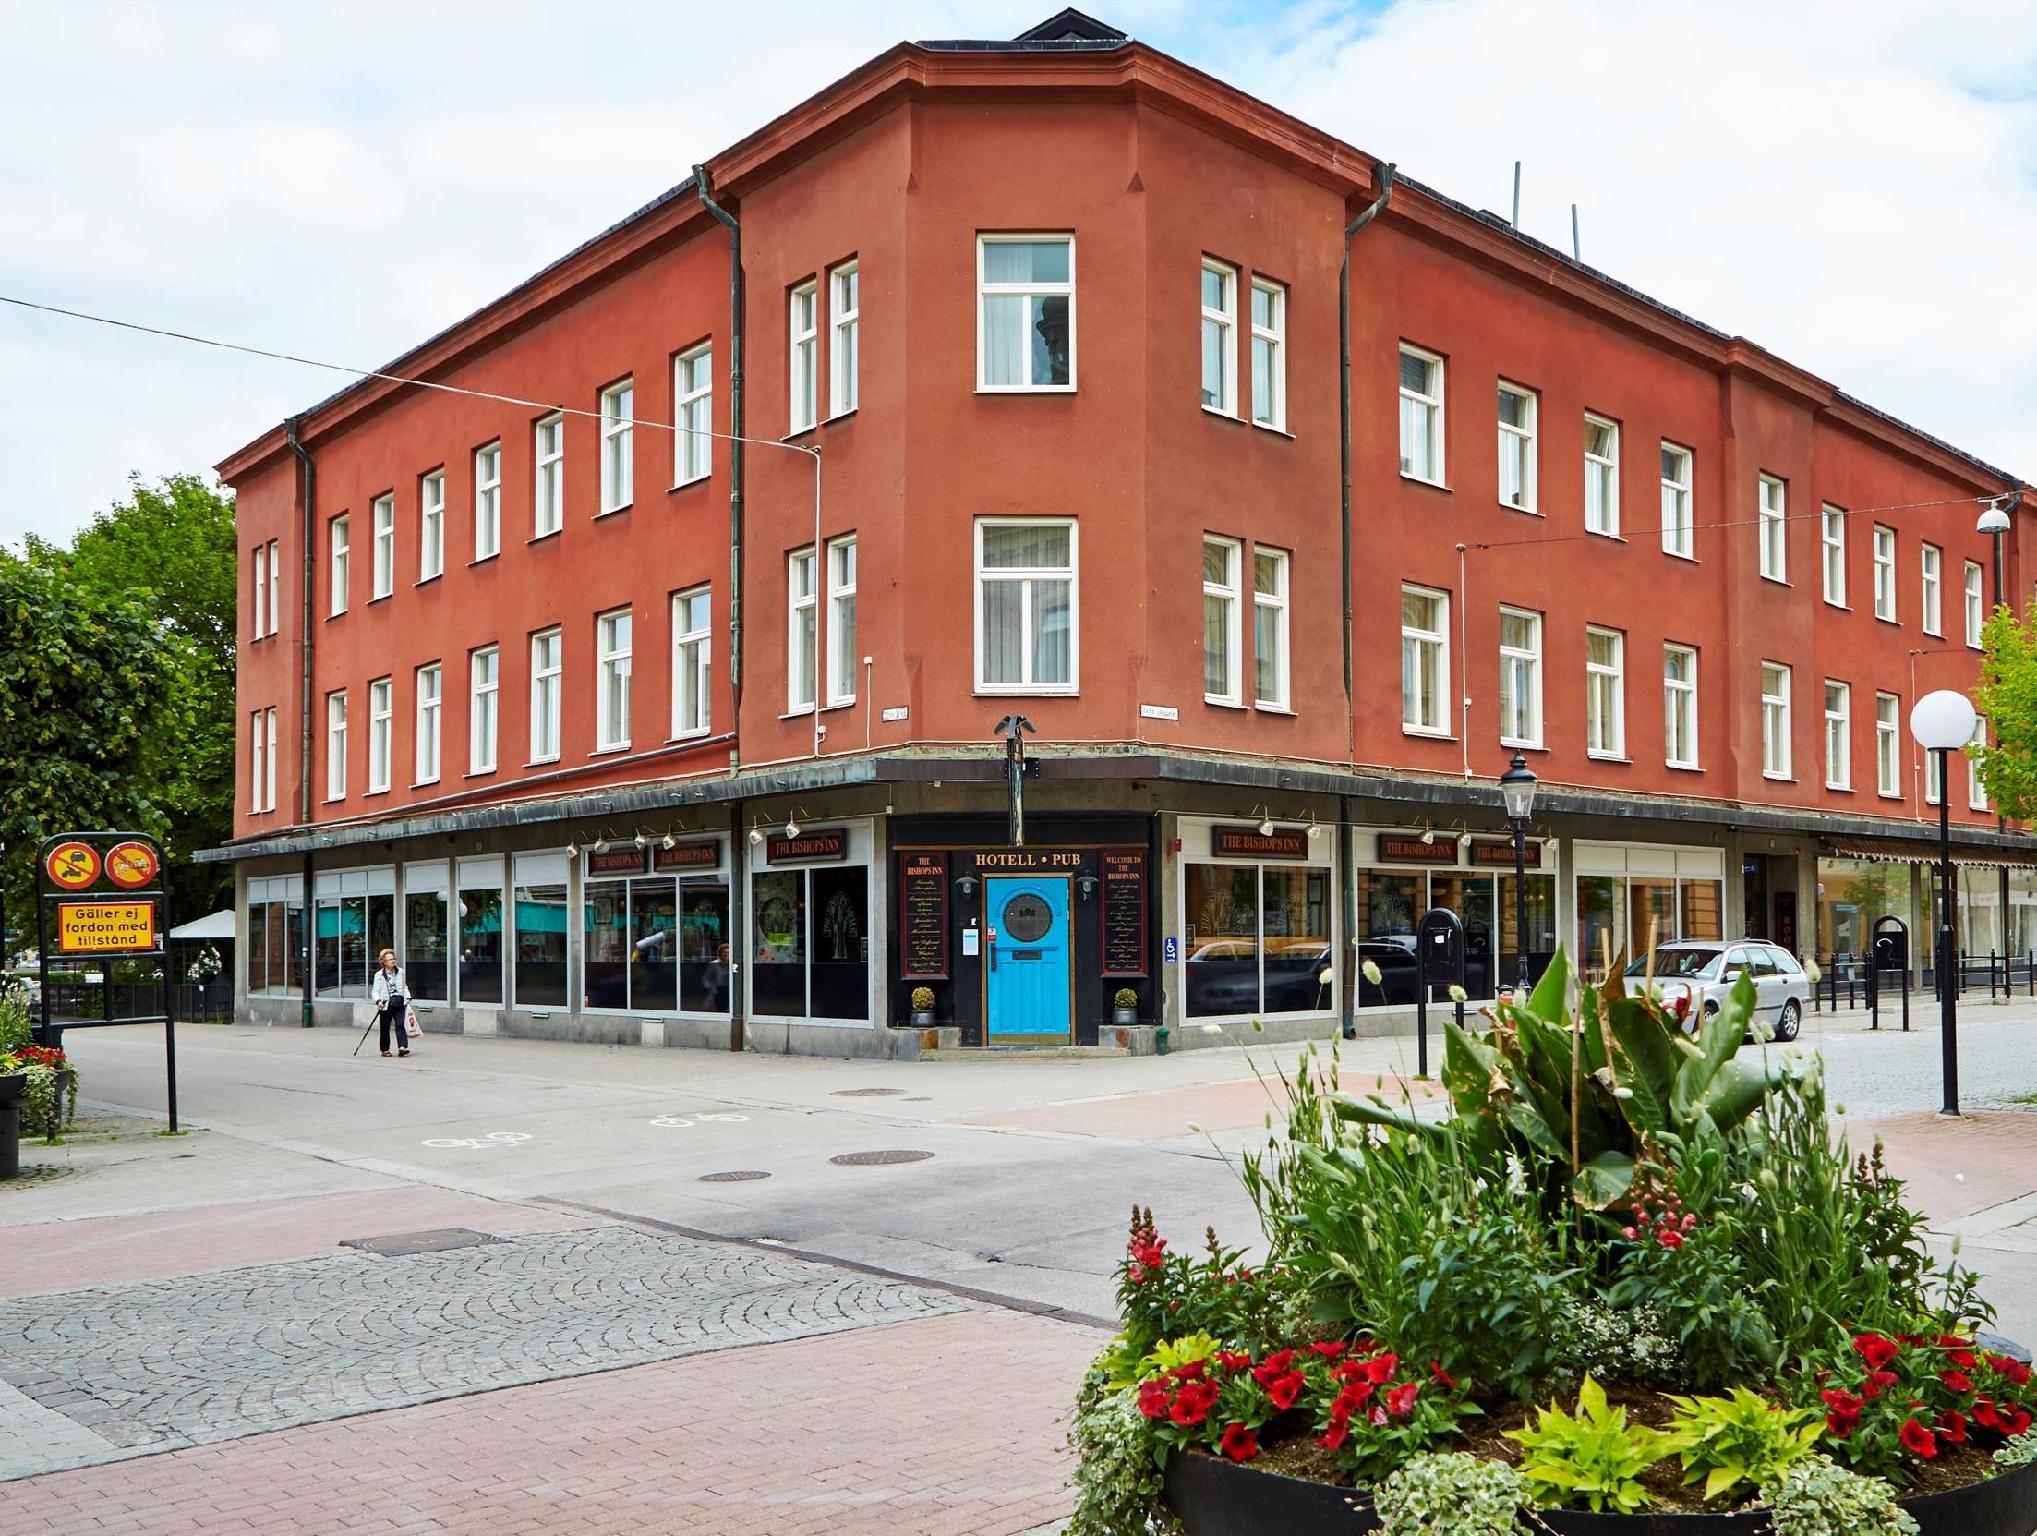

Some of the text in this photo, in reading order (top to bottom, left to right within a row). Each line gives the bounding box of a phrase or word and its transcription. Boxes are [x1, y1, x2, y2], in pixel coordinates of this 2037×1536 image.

[776, 838, 839, 855] THE BISHOPS INN
[1222, 835, 1300, 851] THE BISHOPS INN
[1386, 842, 1403, 855] THE
[918, 857, 929, 866] THE
[976, 853, 1081, 866] HOTELL PUB
[1106, 856, 1141, 864] WELCOME TO
[908, 866, 942, 876] BISHOPS INN
[1118, 864, 1128, 872] THE
[1129, 872, 1140, 880] INN
[76, 908, 138, 920] Gäller ej
[65, 921, 148, 933] fordon med
[78, 934, 137, 946] tillstånd
